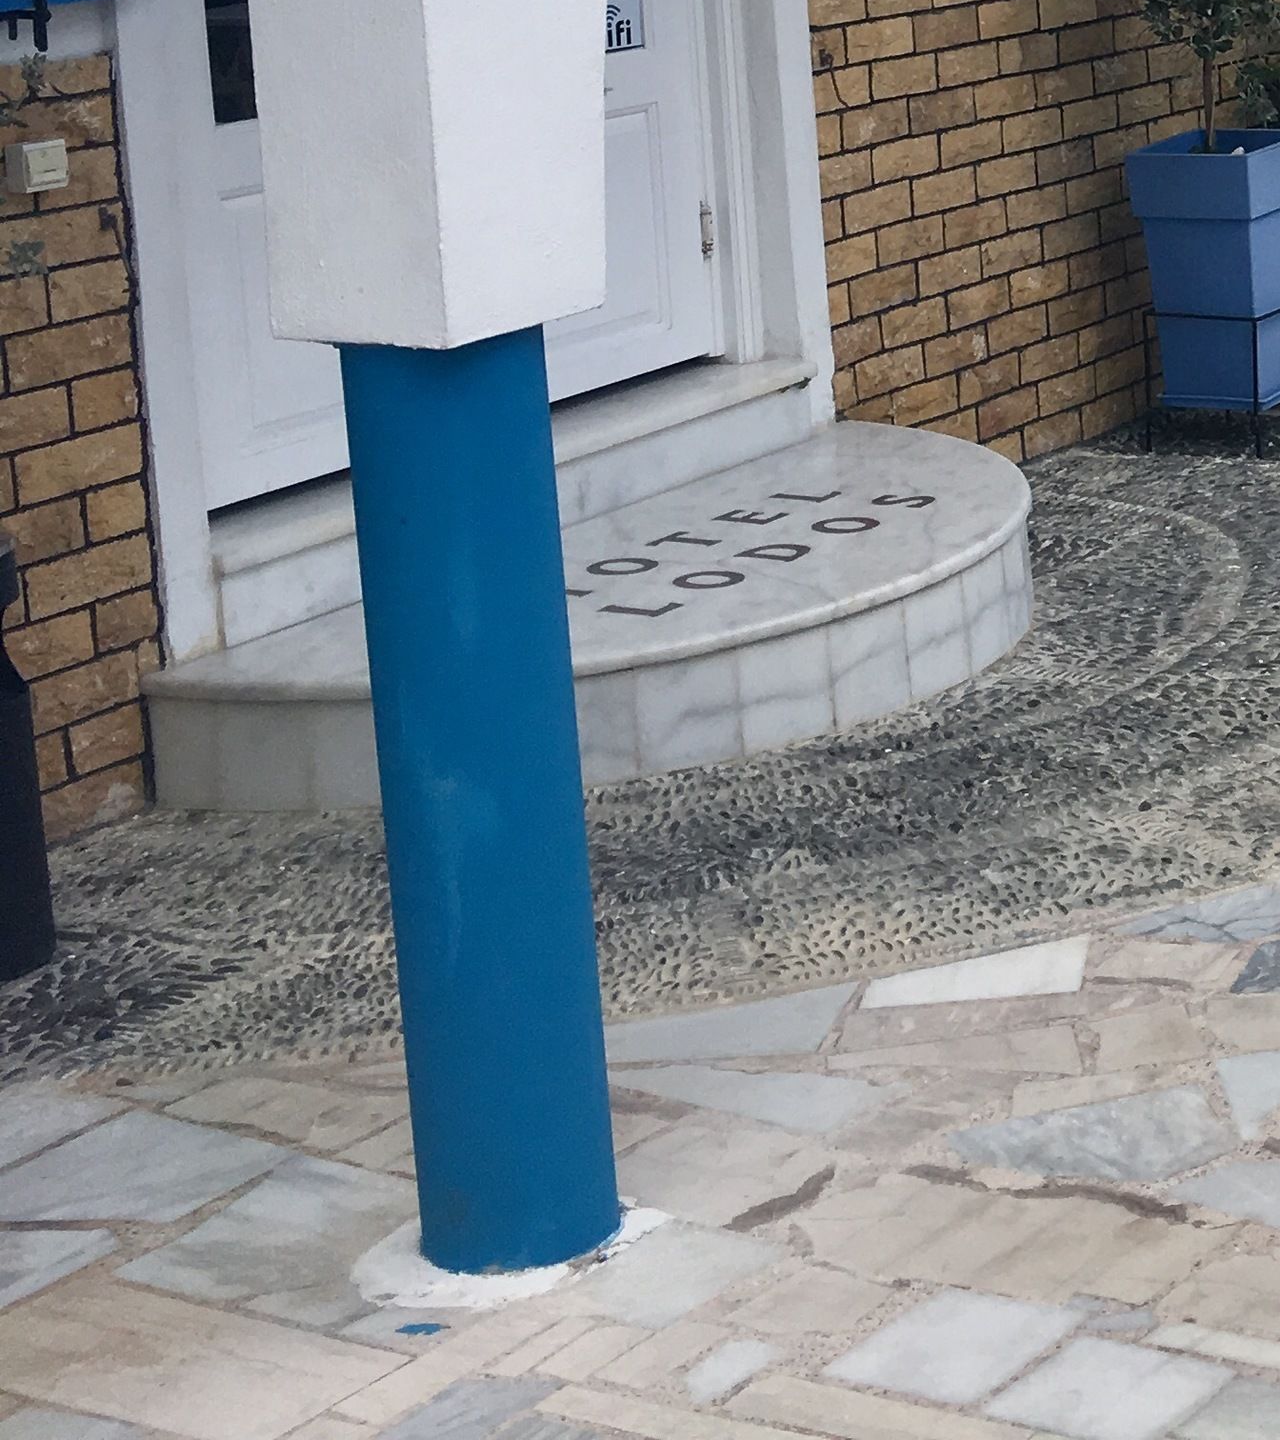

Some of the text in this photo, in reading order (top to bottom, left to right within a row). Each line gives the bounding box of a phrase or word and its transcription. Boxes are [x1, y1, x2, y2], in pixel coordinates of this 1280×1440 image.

[607, 19, 632, 47] ifi
[566, 490, 841, 598] OTEL
[597, 493, 936, 617] LODOS
